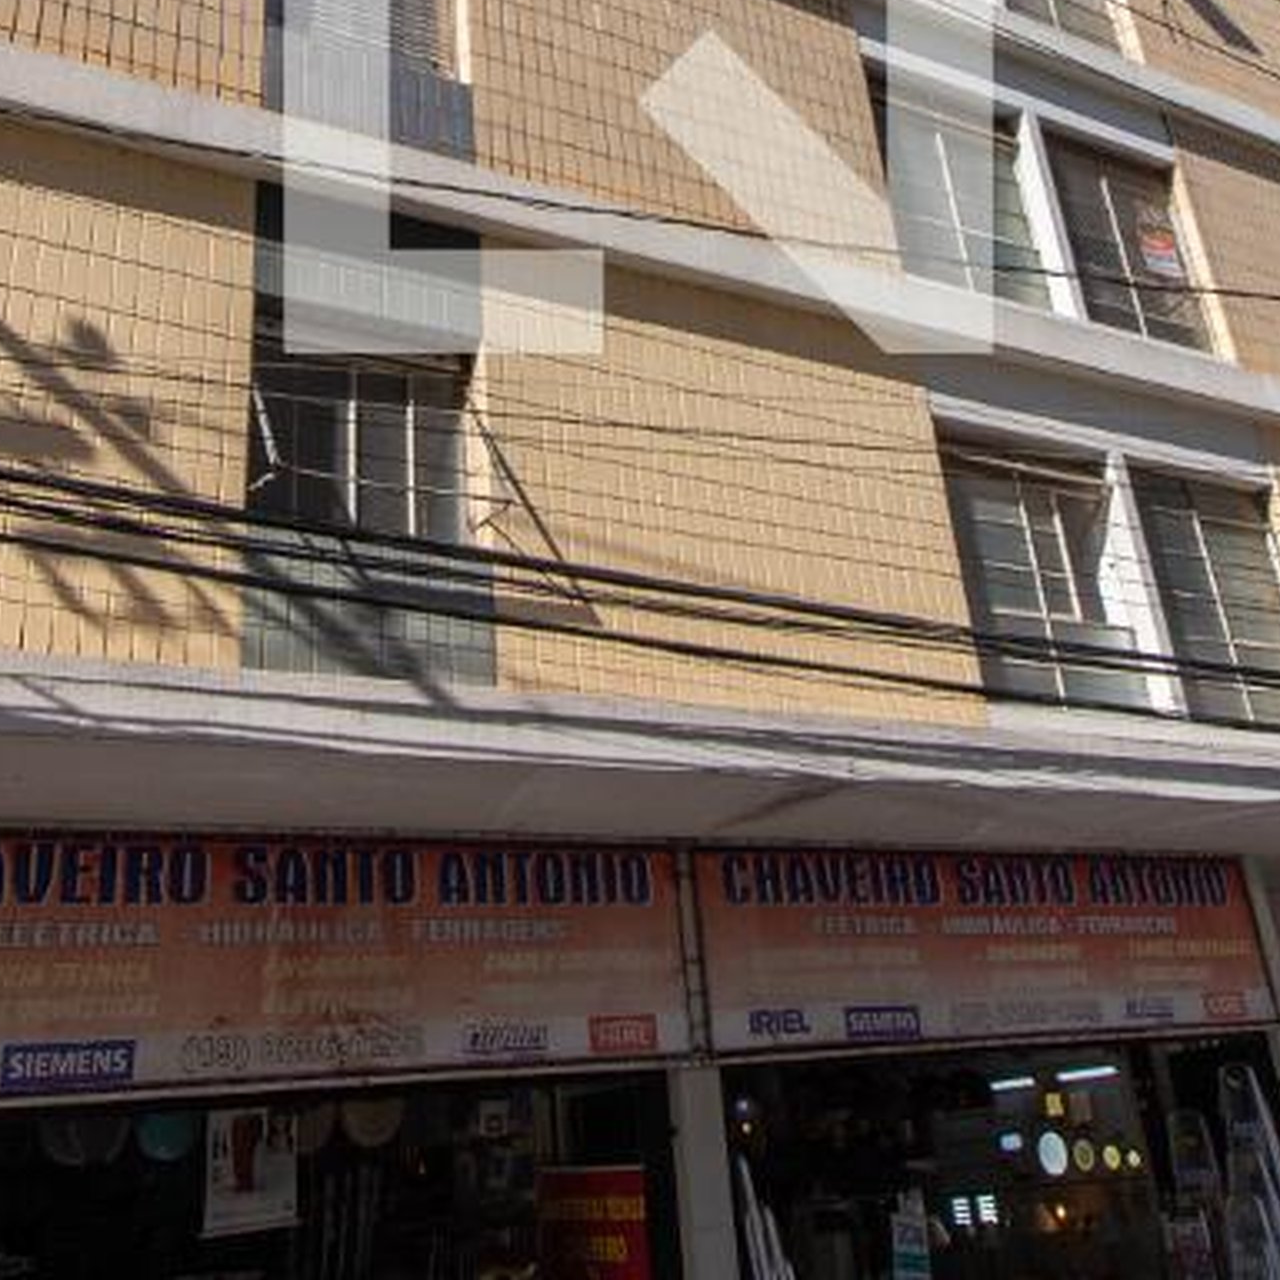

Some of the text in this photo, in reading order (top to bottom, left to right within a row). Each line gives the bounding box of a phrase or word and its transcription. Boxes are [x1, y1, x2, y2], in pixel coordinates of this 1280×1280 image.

[234, 846, 418, 906] SANTO
[437, 850, 654, 907] ANTONIO
[722, 852, 1228, 907] CHAVEIRO SANTO ANTONIO
[7, 1048, 129, 1079] SIEMENS
